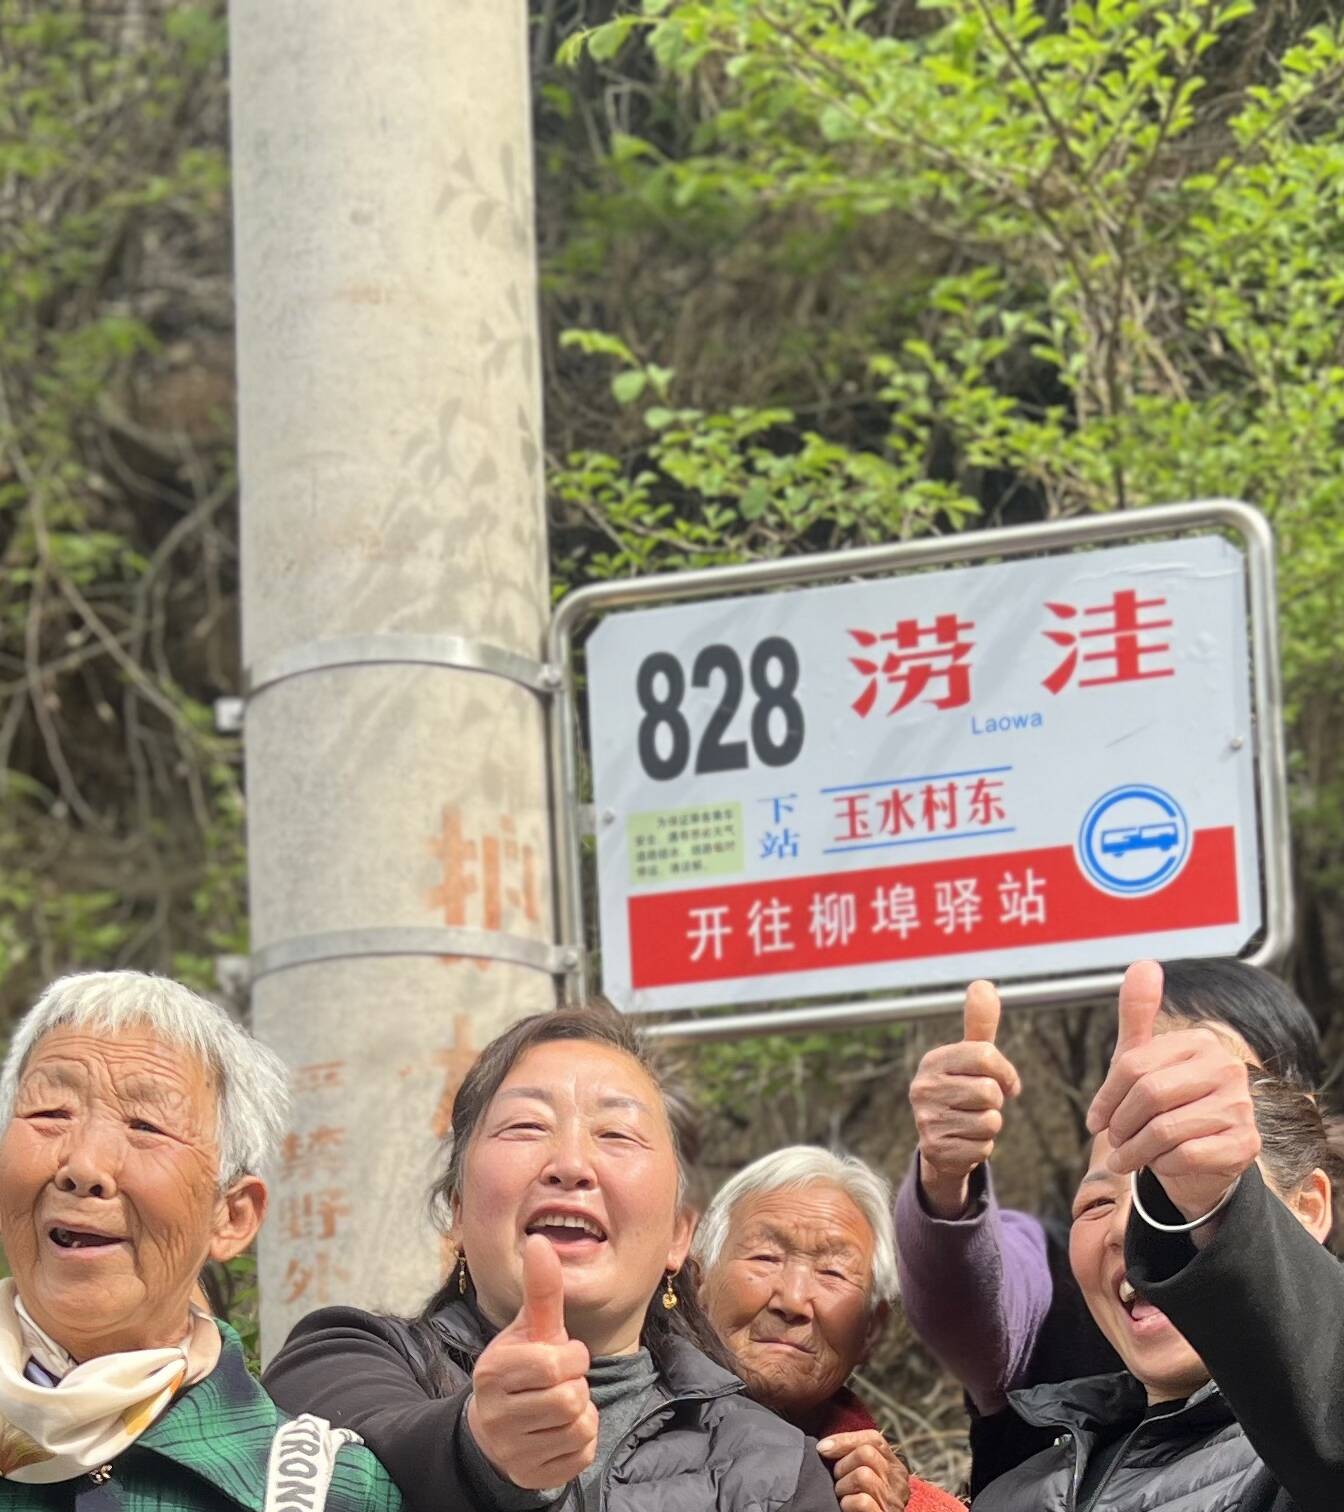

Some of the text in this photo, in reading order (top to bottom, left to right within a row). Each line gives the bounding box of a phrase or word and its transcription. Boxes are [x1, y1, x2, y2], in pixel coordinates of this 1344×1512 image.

[637, 636, 805, 781] 828
[971, 711, 1043, 736] Laowa
[833, 778, 1006, 842] 玉水村东
[686, 868, 1047, 962] 开往柳埠驿站
